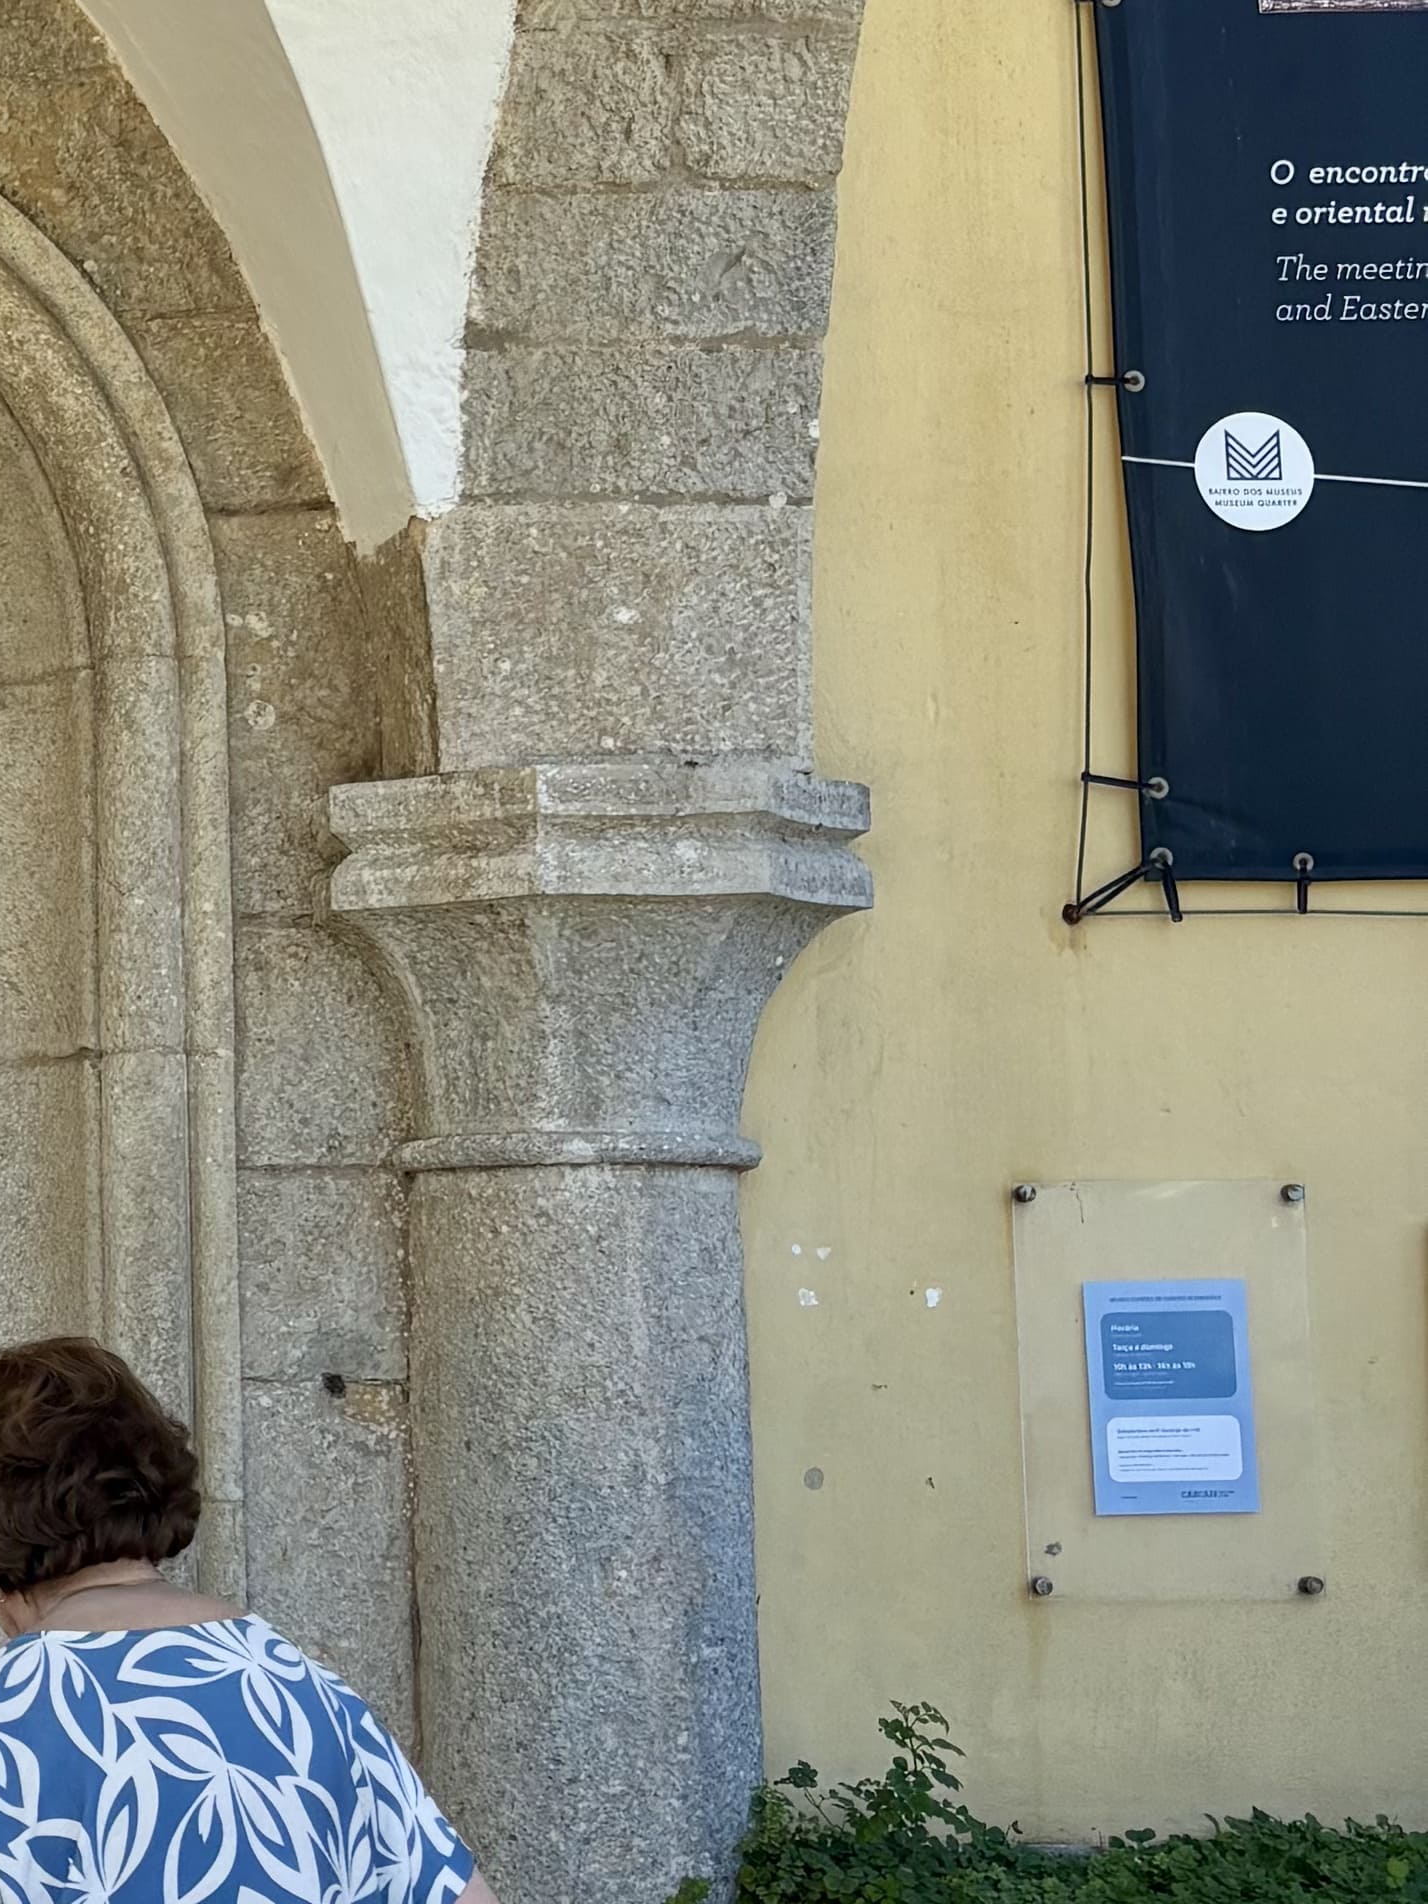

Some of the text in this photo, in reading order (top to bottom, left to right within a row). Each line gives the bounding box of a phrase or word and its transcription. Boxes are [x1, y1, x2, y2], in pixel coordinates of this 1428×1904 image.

[1270, 159, 1428, 185] O encontr
[1271, 207, 1288, 225] e
[1295, 195, 1415, 225] oriental
[1276, 253, 1328, 281] The
[1275, 293, 1332, 322] and
[1214, 499, 1298, 507] MUSEUM QUARTER
[1243, 488, 1263, 496] DOS
